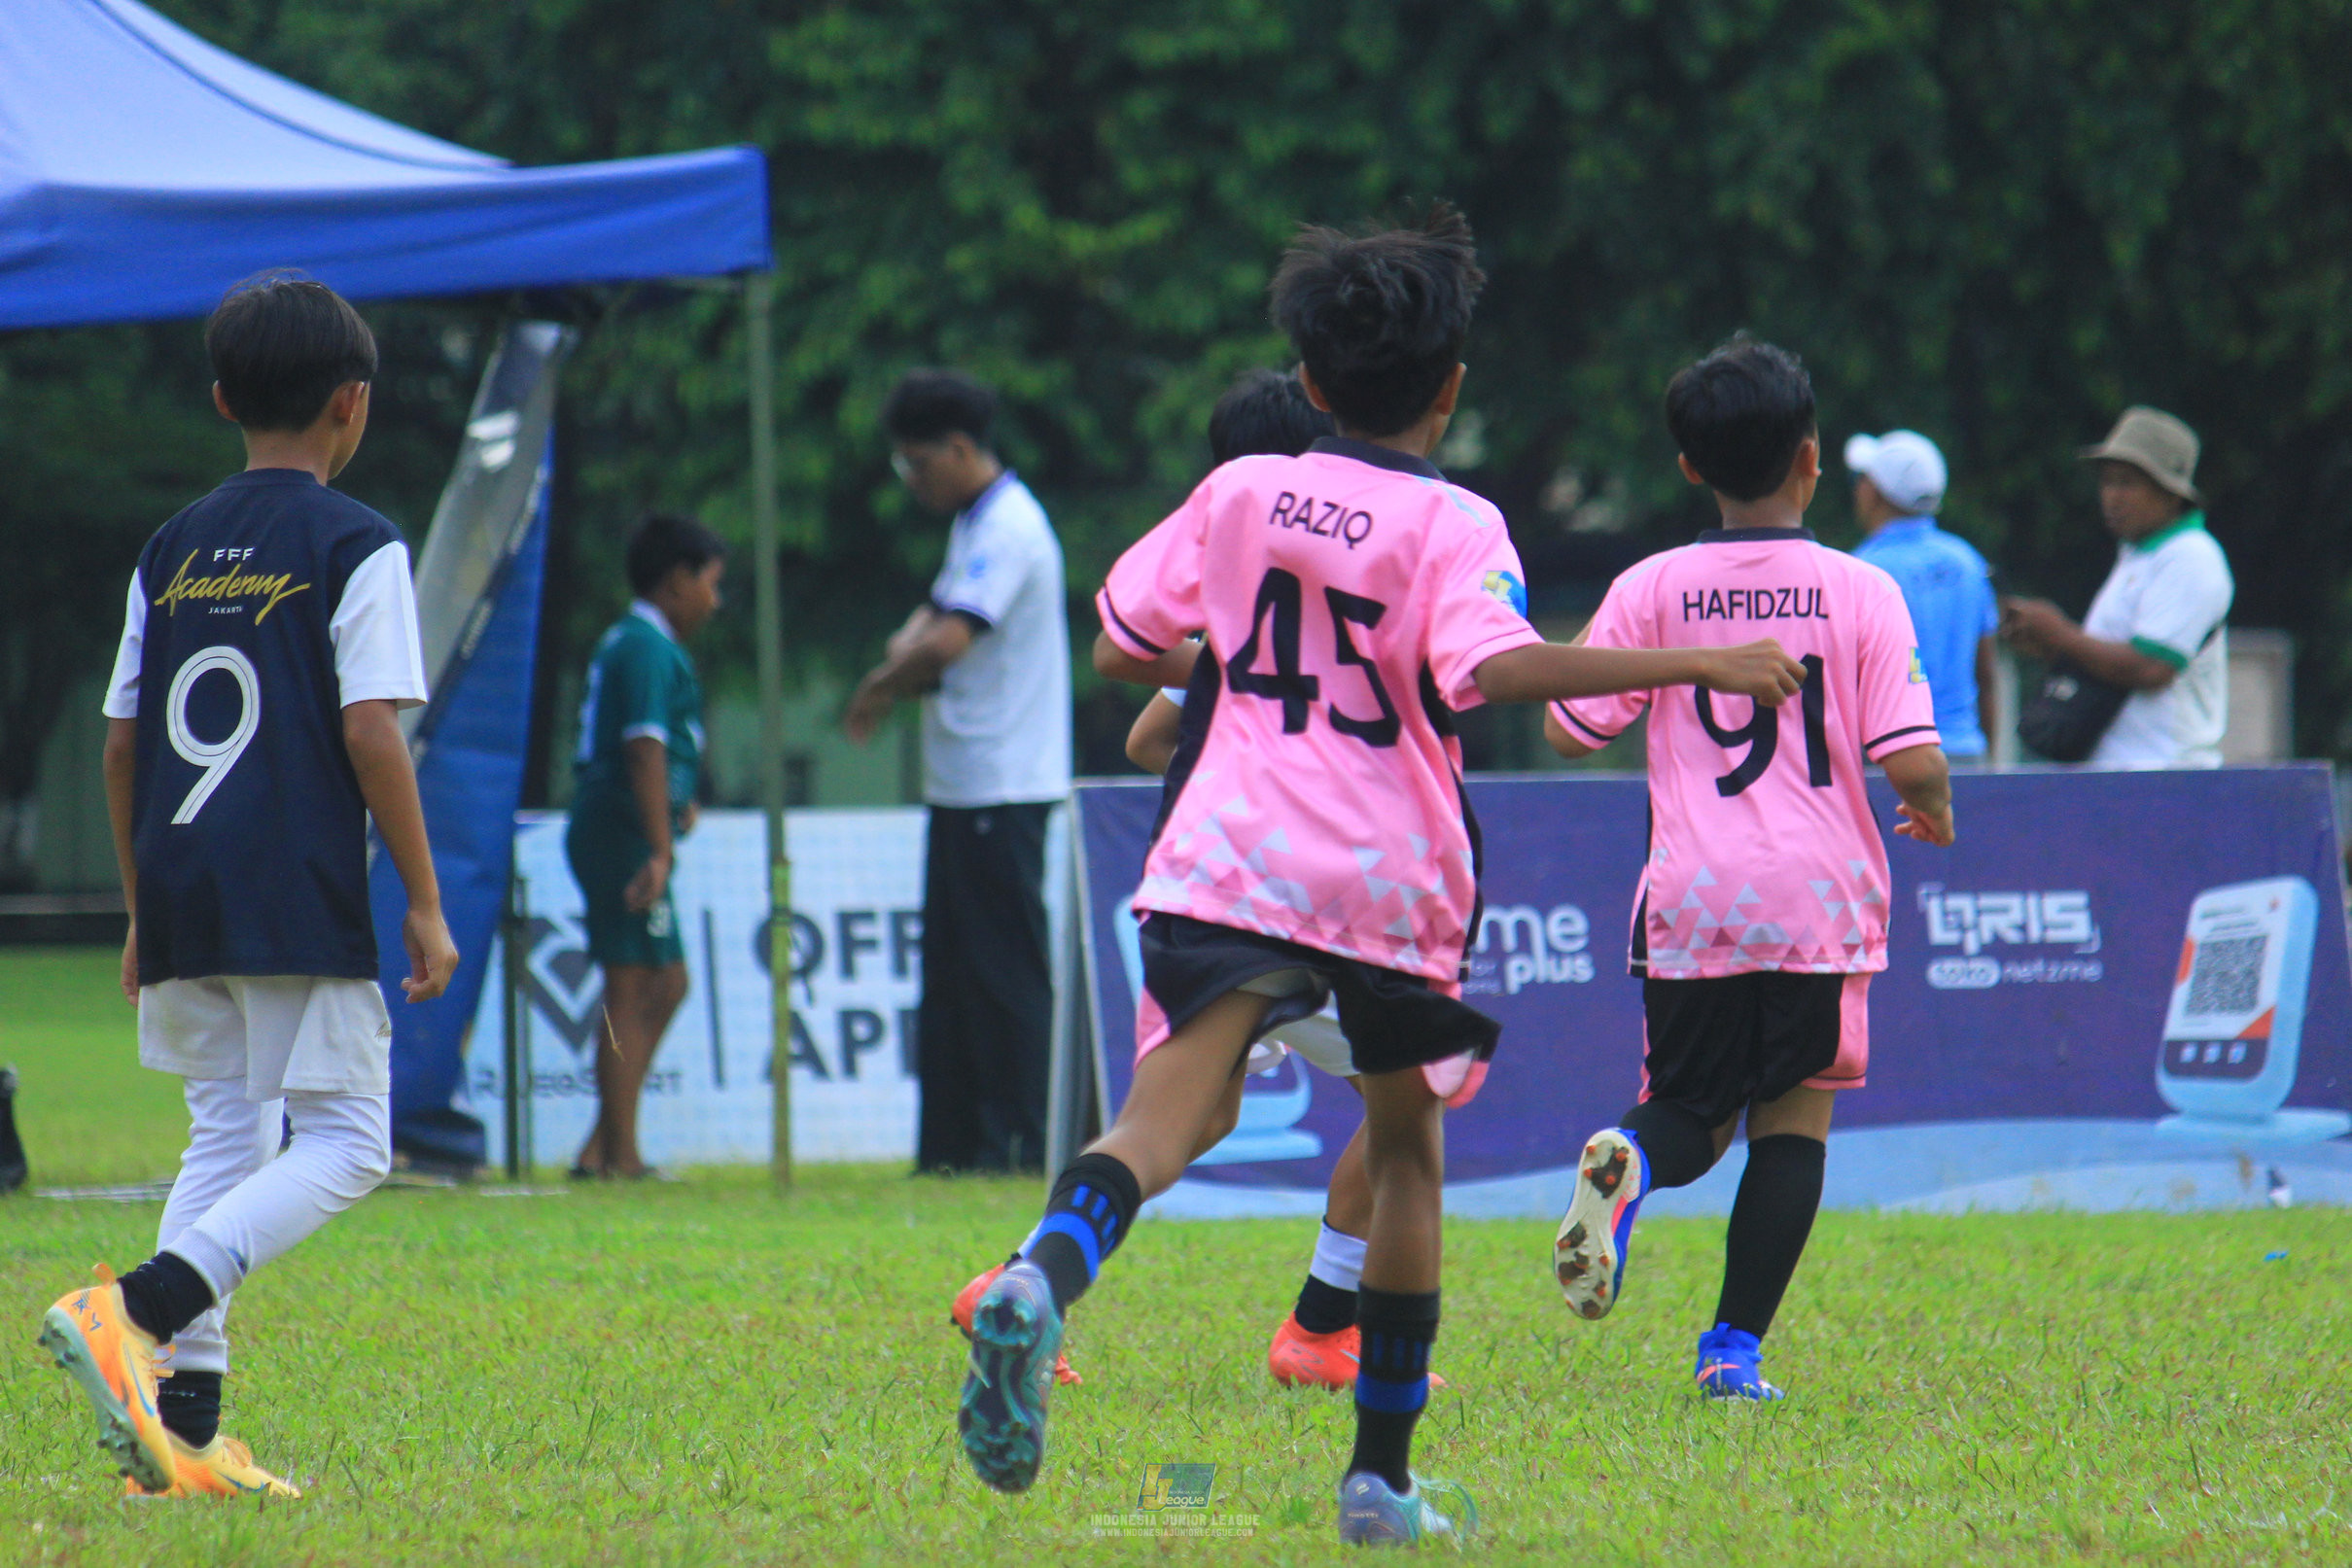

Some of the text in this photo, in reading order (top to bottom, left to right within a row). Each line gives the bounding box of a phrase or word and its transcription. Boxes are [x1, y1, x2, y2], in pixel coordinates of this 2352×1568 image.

[1268, 490, 1374, 550] RAZIQ
[154, 548, 311, 626] Academy
[213, 547, 256, 562] FFF
[1682, 587, 1829, 622] HAFIDZUL
[1226, 567, 1401, 749] 45
[166, 645, 261, 824] 9
[1694, 652, 1833, 797] 91
[754, 909, 924, 979] OFF
[1475, 904, 1590, 954] me
[1926, 890, 2092, 956] QRIS
[1506, 953, 1596, 995] plus
[764, 1008, 922, 1081] AP
